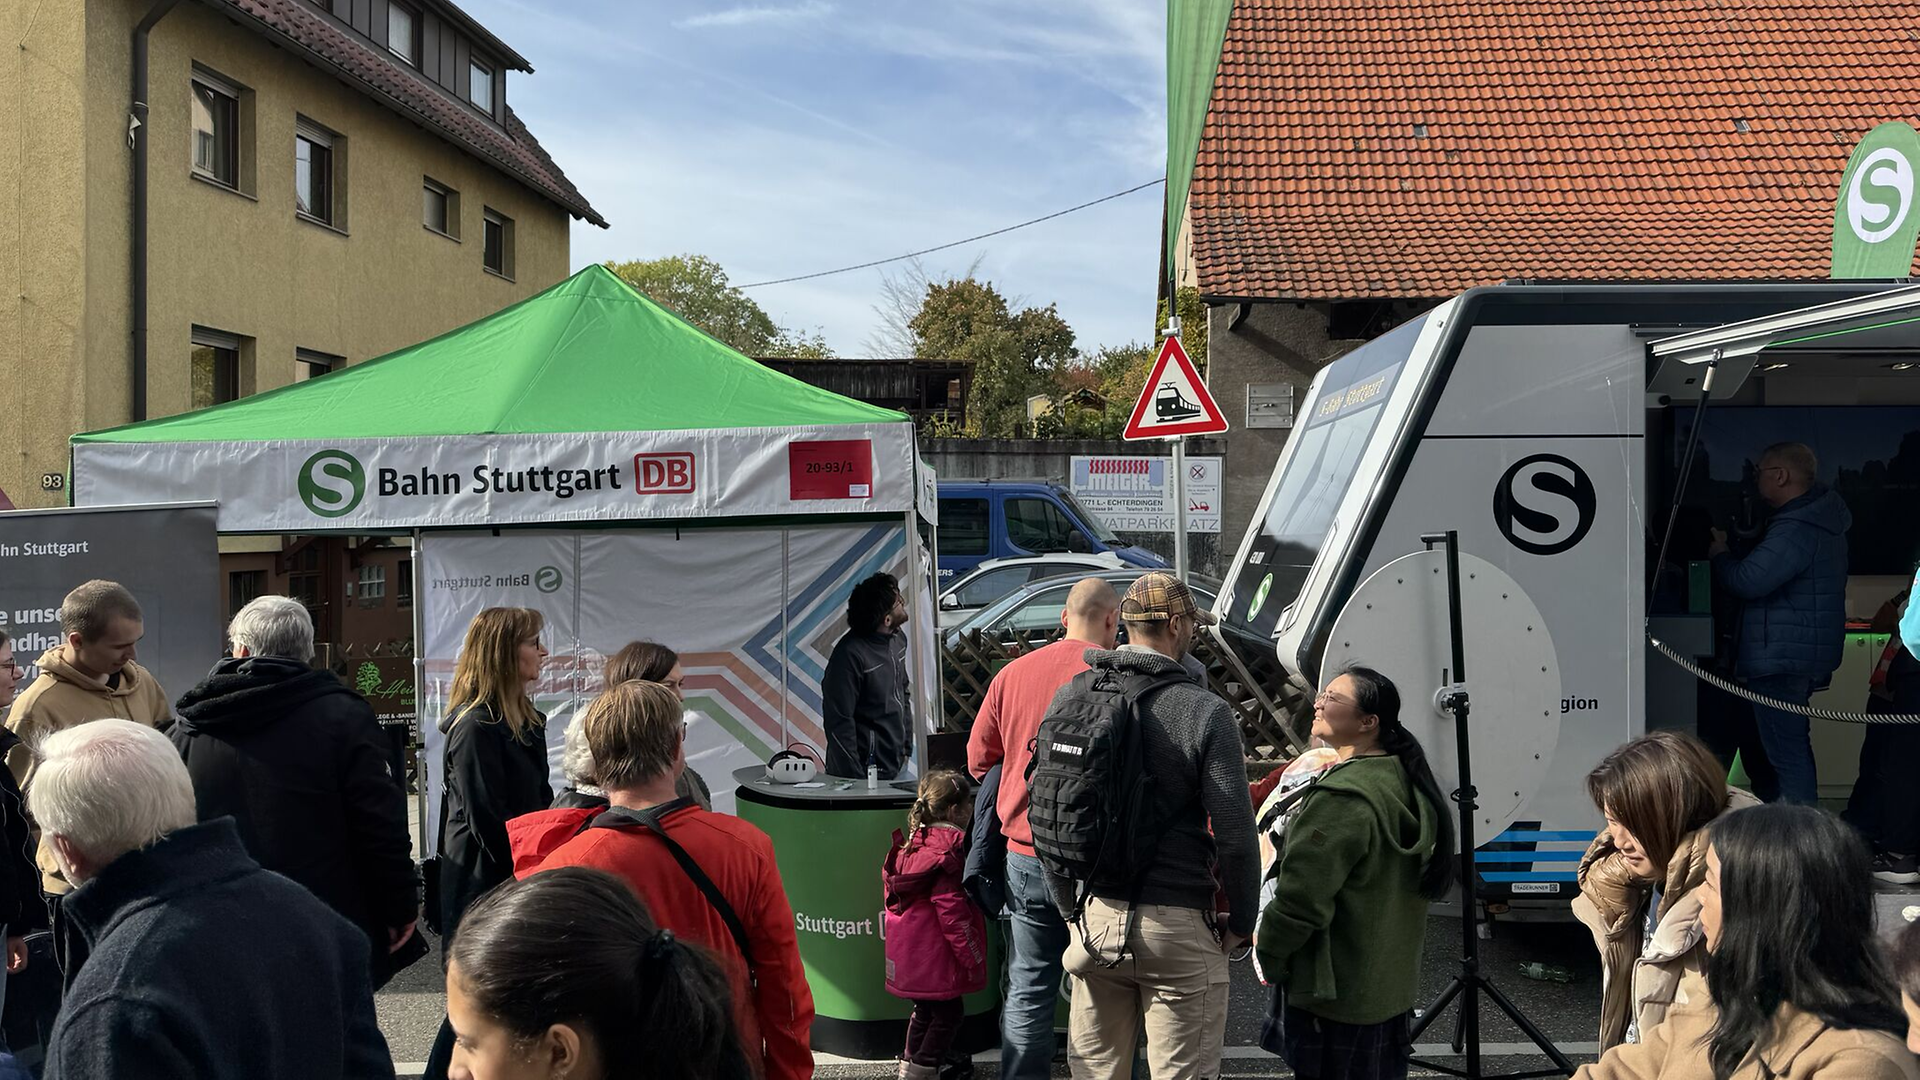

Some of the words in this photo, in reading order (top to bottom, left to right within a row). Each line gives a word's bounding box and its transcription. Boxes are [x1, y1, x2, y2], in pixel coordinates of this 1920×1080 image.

[1855, 154, 1906, 236] S
[43, 475, 62, 488] 93
[640, 457, 691, 490] DB
[806, 461, 854, 475] 20-93/1
[305, 454, 361, 514] S
[378, 467, 461, 496] Bahn
[472, 463, 622, 499] Stuttgart
[1507, 458, 1584, 549] S
[23, 541, 89, 557] Stuttgart
[796, 912, 873, 939] Stuttgart
